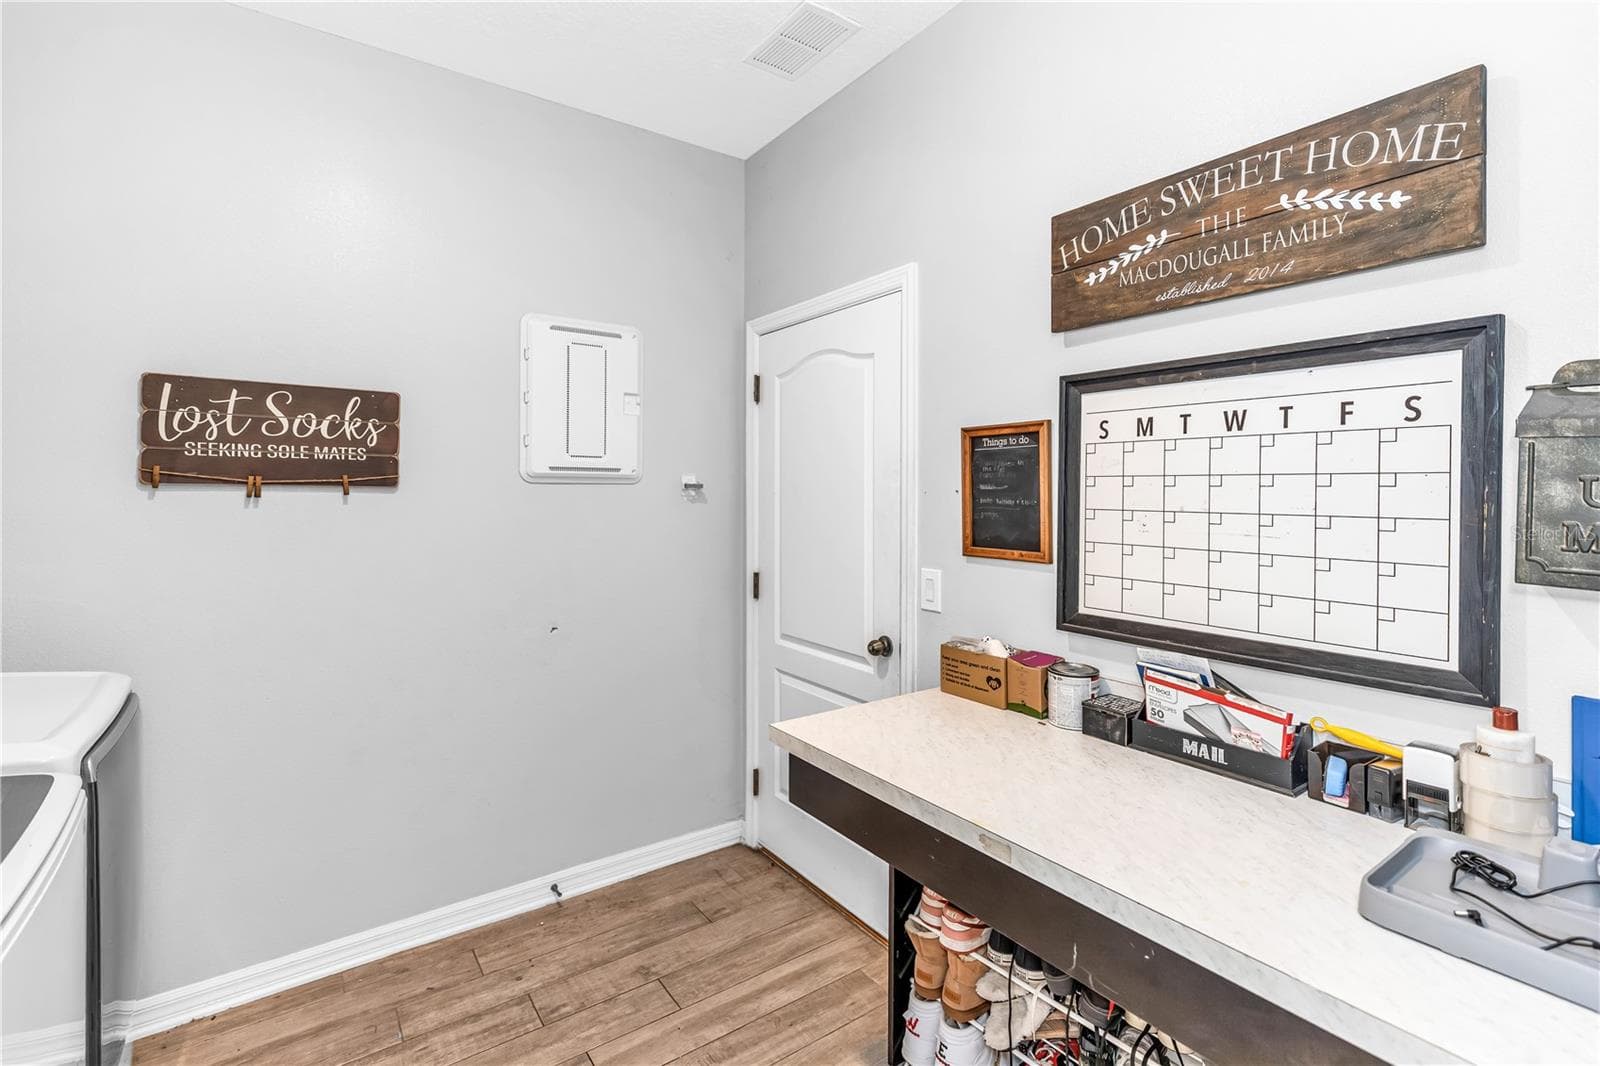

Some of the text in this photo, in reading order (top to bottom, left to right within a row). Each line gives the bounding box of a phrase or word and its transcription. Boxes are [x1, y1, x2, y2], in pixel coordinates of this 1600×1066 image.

[1058, 120, 1468, 271] HOME SWEET HOME
[1194, 205, 1247, 238] THE
[1118, 211, 1350, 289] MACDOUGALL FAMILY
[1155, 259, 1296, 302] established 2014
[157, 382, 387, 448] Lost Socks
[1098, 395, 1423, 440] S M T W T F S
[183, 441, 367, 461] SEEKING SOLE MATES
[982, 434, 1030, 448] Things to do
[1150, 707, 1165, 719] 50
[1182, 738, 1229, 766] MAIL
